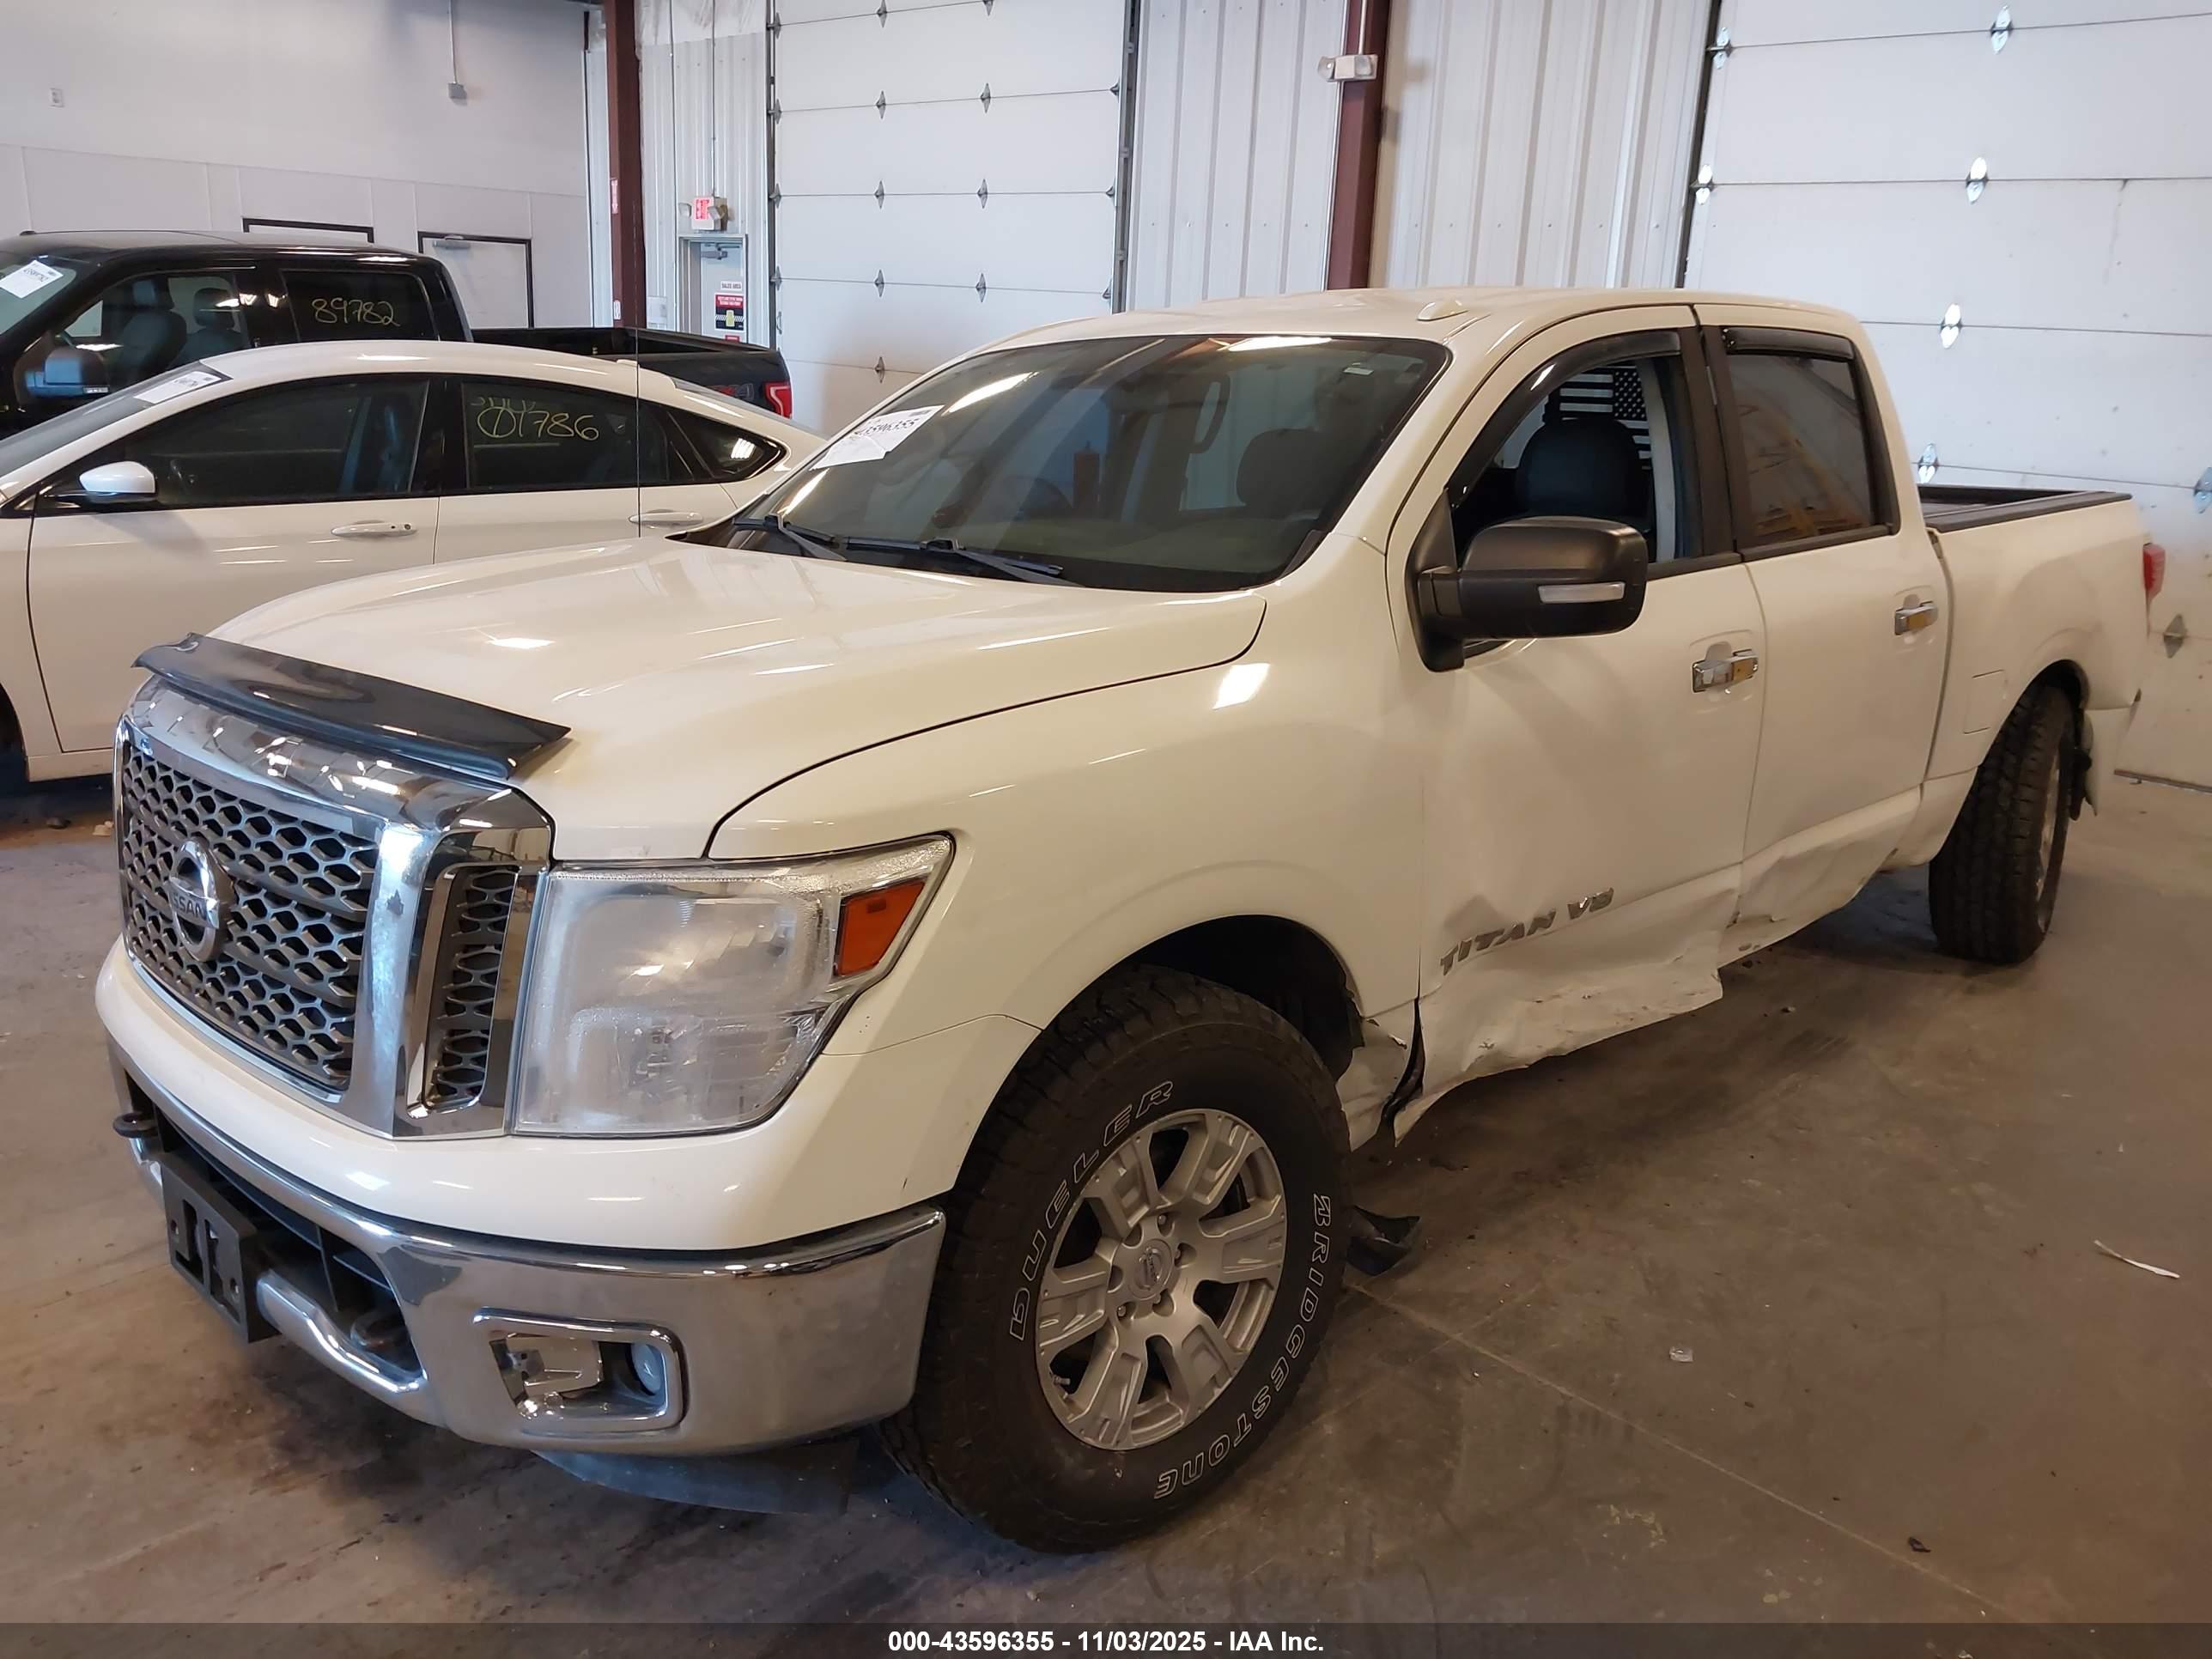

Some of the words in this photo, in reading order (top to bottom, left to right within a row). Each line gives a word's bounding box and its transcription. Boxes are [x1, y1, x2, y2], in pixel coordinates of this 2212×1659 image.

[312, 297, 401, 327] 89782
[1439, 908, 1557, 976] TITAN
[1010, 1080, 1174, 1341] DUELER
[1154, 1193, 1332, 1499] BRIDGESTONE
